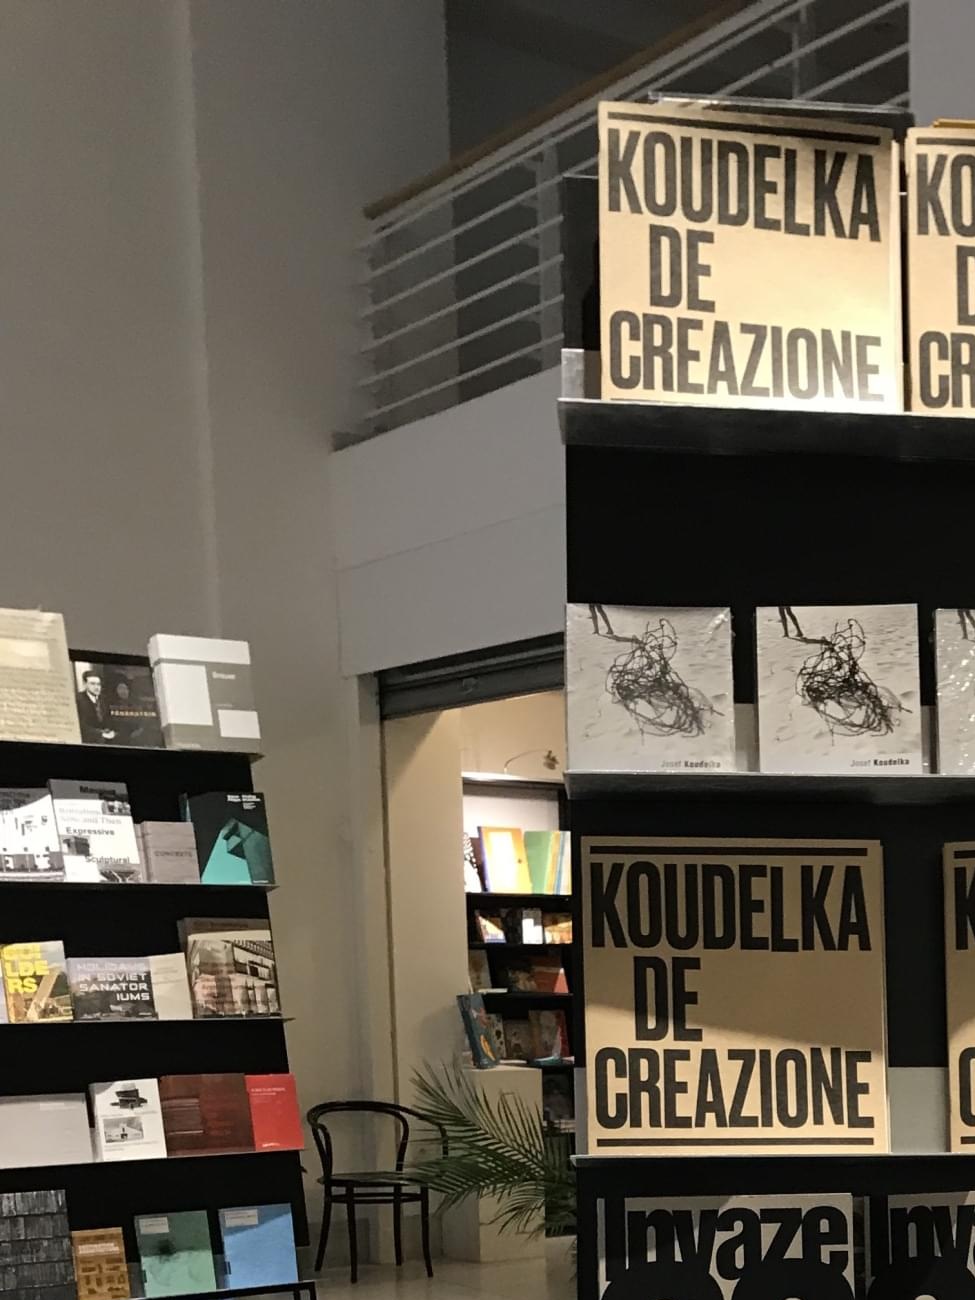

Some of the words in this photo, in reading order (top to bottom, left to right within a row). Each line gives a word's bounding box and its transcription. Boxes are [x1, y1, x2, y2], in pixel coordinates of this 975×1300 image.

[607, 128, 881, 242] KOUDELKA
[649, 224, 715, 313] DE
[609, 310, 884, 402] CREAZIONE
[873, 757, 910, 767] Koudelka
[66, 826, 115, 836] Expressive
[85, 855, 130, 865] Sculptural
[589, 861, 871, 952] KOUDELKA
[7, 977, 38, 993] RS
[79, 983, 148, 992] SANATOR
[97, 972, 147, 981] SOVIET
[116, 992, 150, 1001] IUMS
[633, 956, 703, 1042] DE
[594, 1047, 875, 1129] CREAZIONE
[605, 1203, 849, 1282] Invaze
